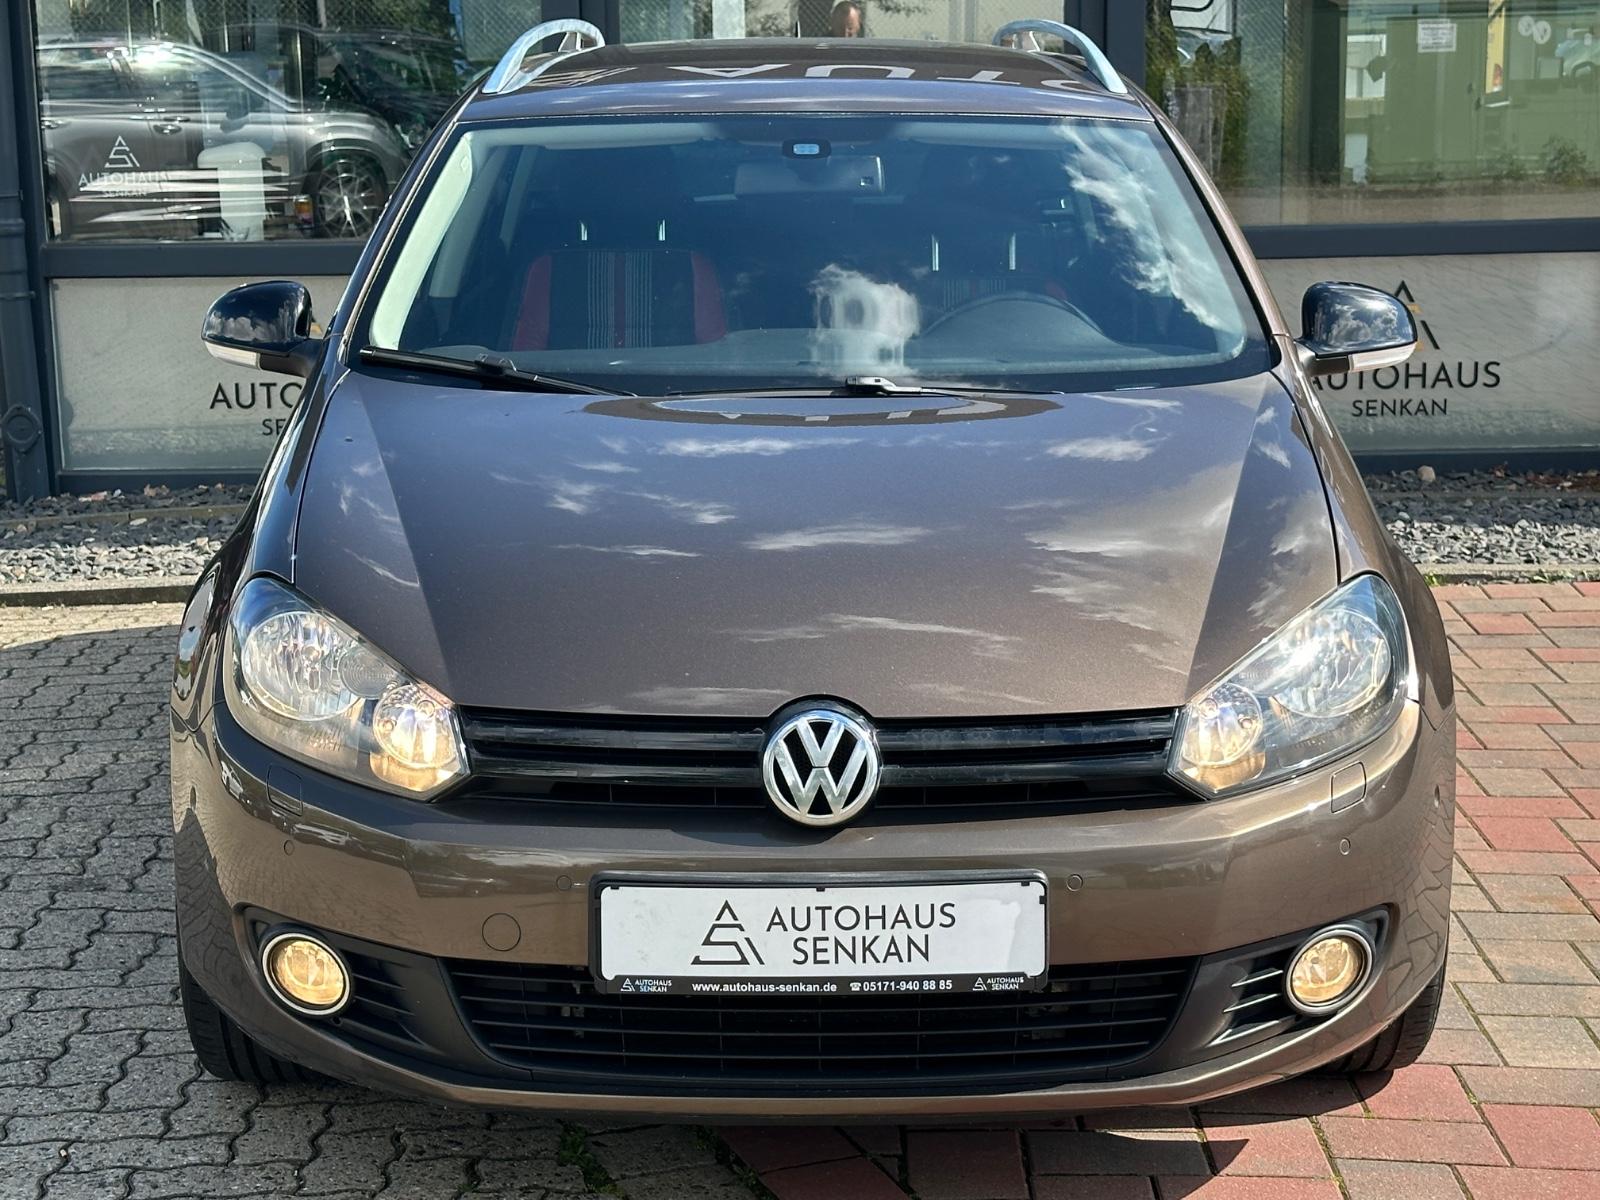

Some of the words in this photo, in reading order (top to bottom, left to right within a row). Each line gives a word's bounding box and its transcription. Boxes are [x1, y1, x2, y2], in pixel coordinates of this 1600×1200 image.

[1351, 398, 1448, 417] SENKAN
[766, 902, 956, 932] AUTOHAUS
[792, 933, 930, 965] SENKAN
[692, 982, 837, 992] www.autohaus-senkan.de
[923, 980, 936, 990] 88
[939, 980, 953, 990] 85
[987, 976, 1024, 984] AUTOHAUS
